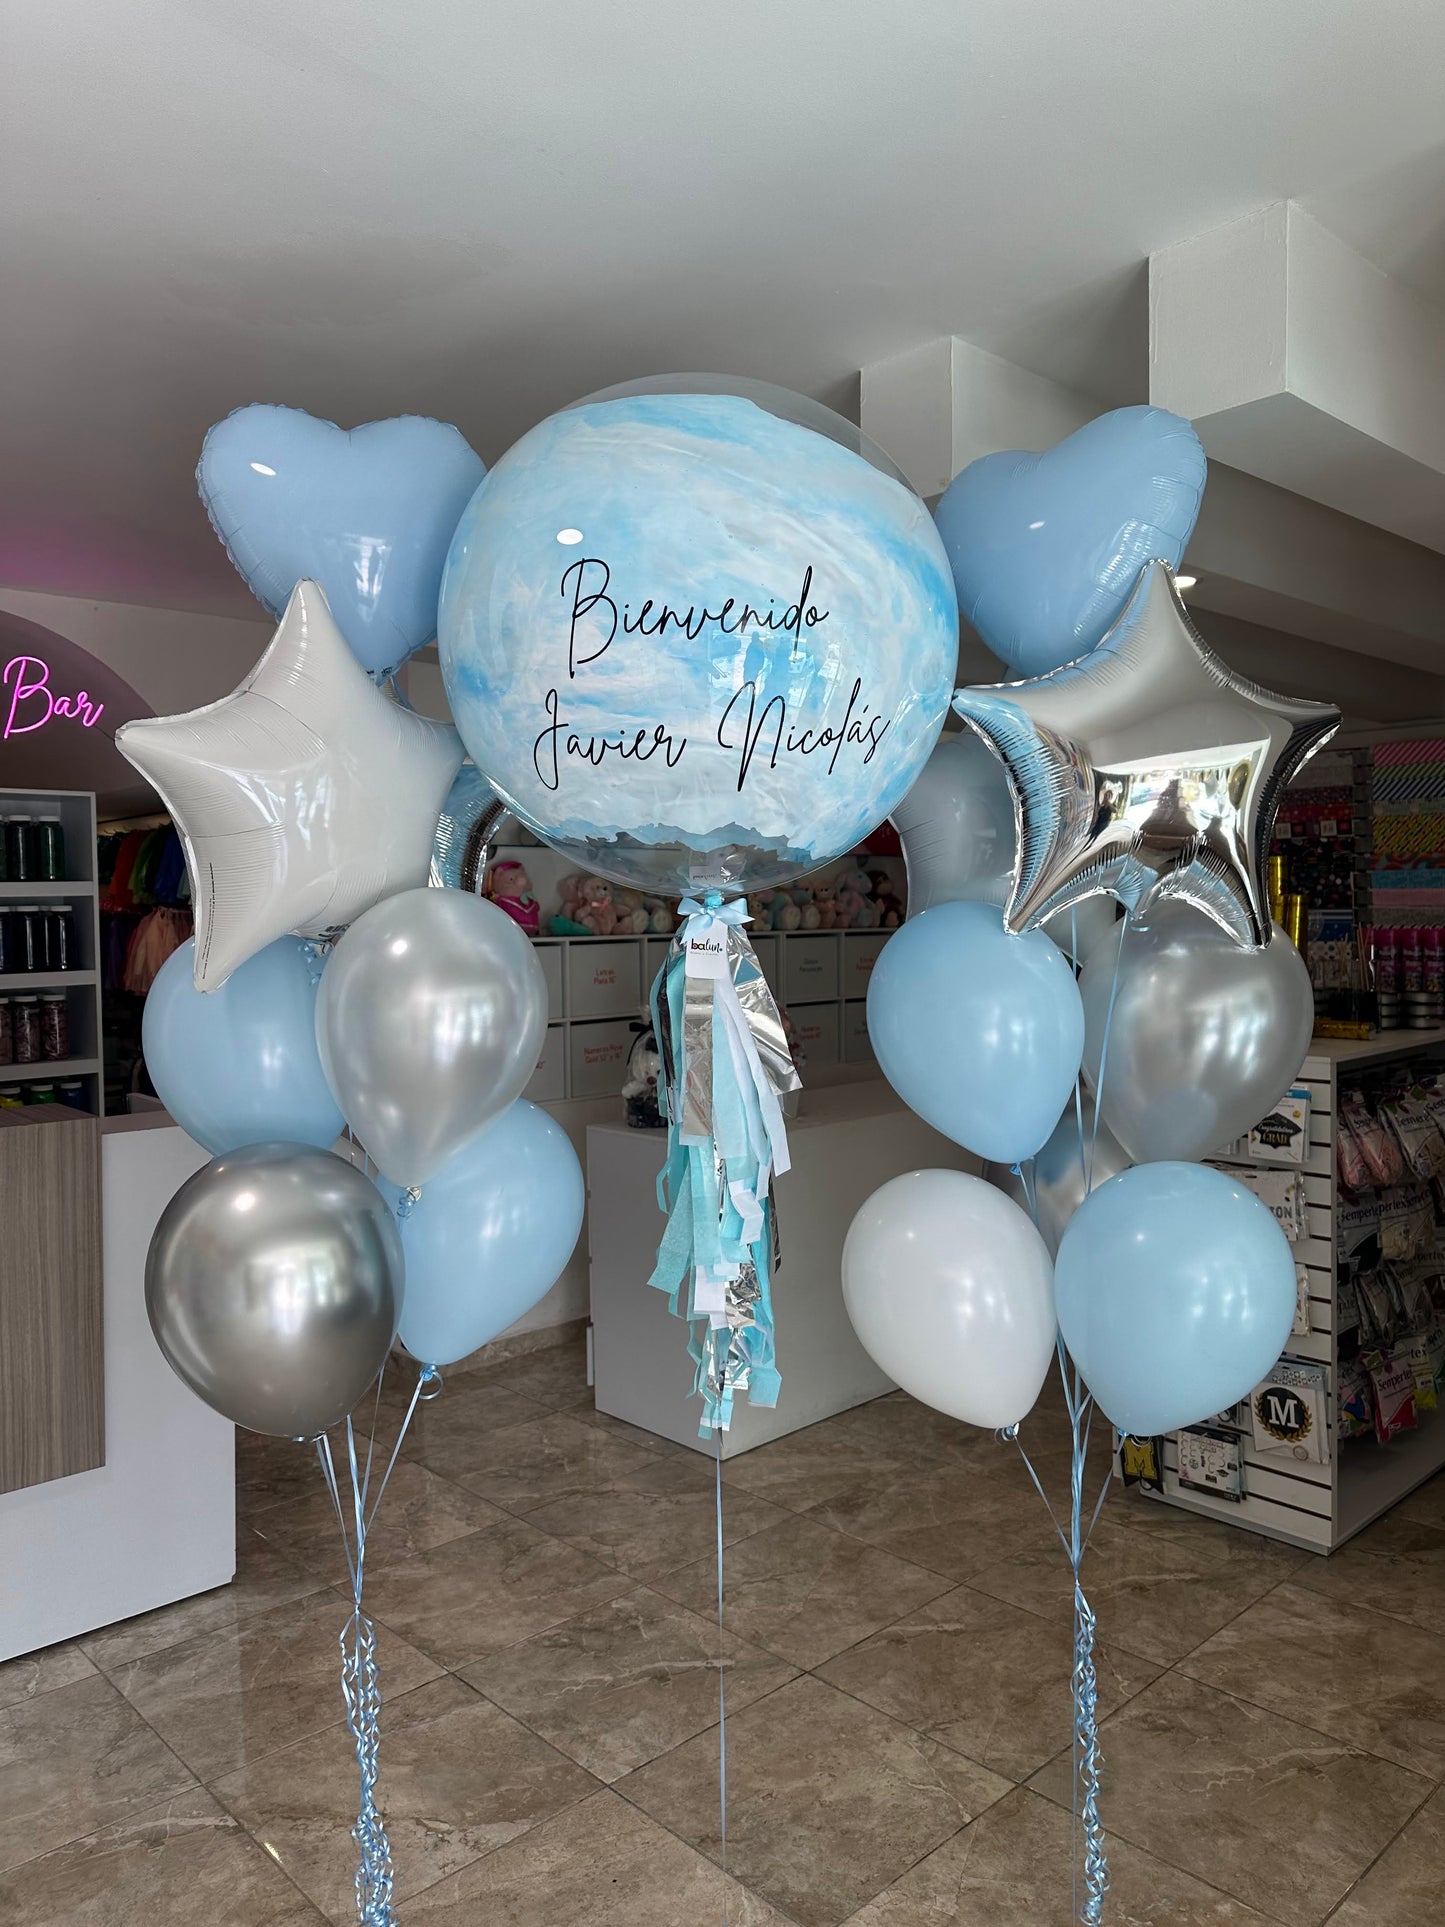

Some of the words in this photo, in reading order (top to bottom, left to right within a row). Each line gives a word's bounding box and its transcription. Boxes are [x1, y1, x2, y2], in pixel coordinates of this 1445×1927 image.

[561, 557, 829, 679] Bienvenido
[3, 655, 104, 739] Bar
[533, 688, 687, 790] Javier
[717, 677, 891, 792] Nicolás
[1263, 1132, 1288, 1144] GRAD
[1265, 1394, 1301, 1429] M
[1122, 1437, 1158, 1480] M
